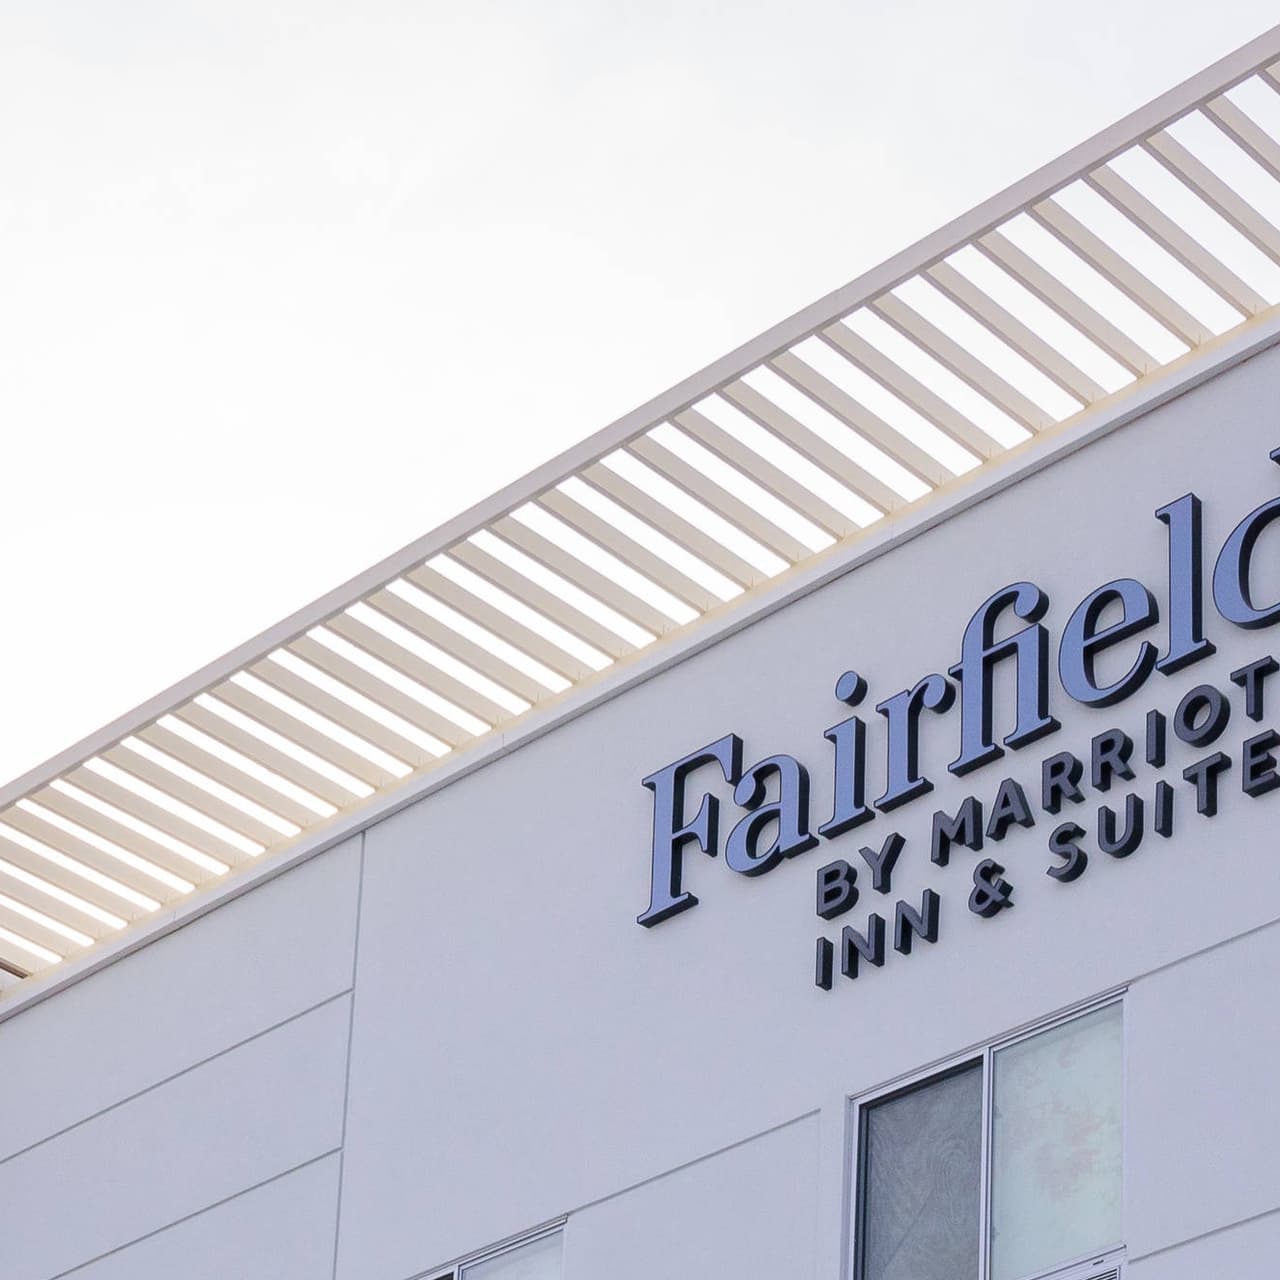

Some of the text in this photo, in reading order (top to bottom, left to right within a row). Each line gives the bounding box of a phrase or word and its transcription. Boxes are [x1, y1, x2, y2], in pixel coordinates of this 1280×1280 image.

[815, 888, 941, 991] INN
[968, 858, 1014, 918] &
[816, 832, 906, 921] BY
